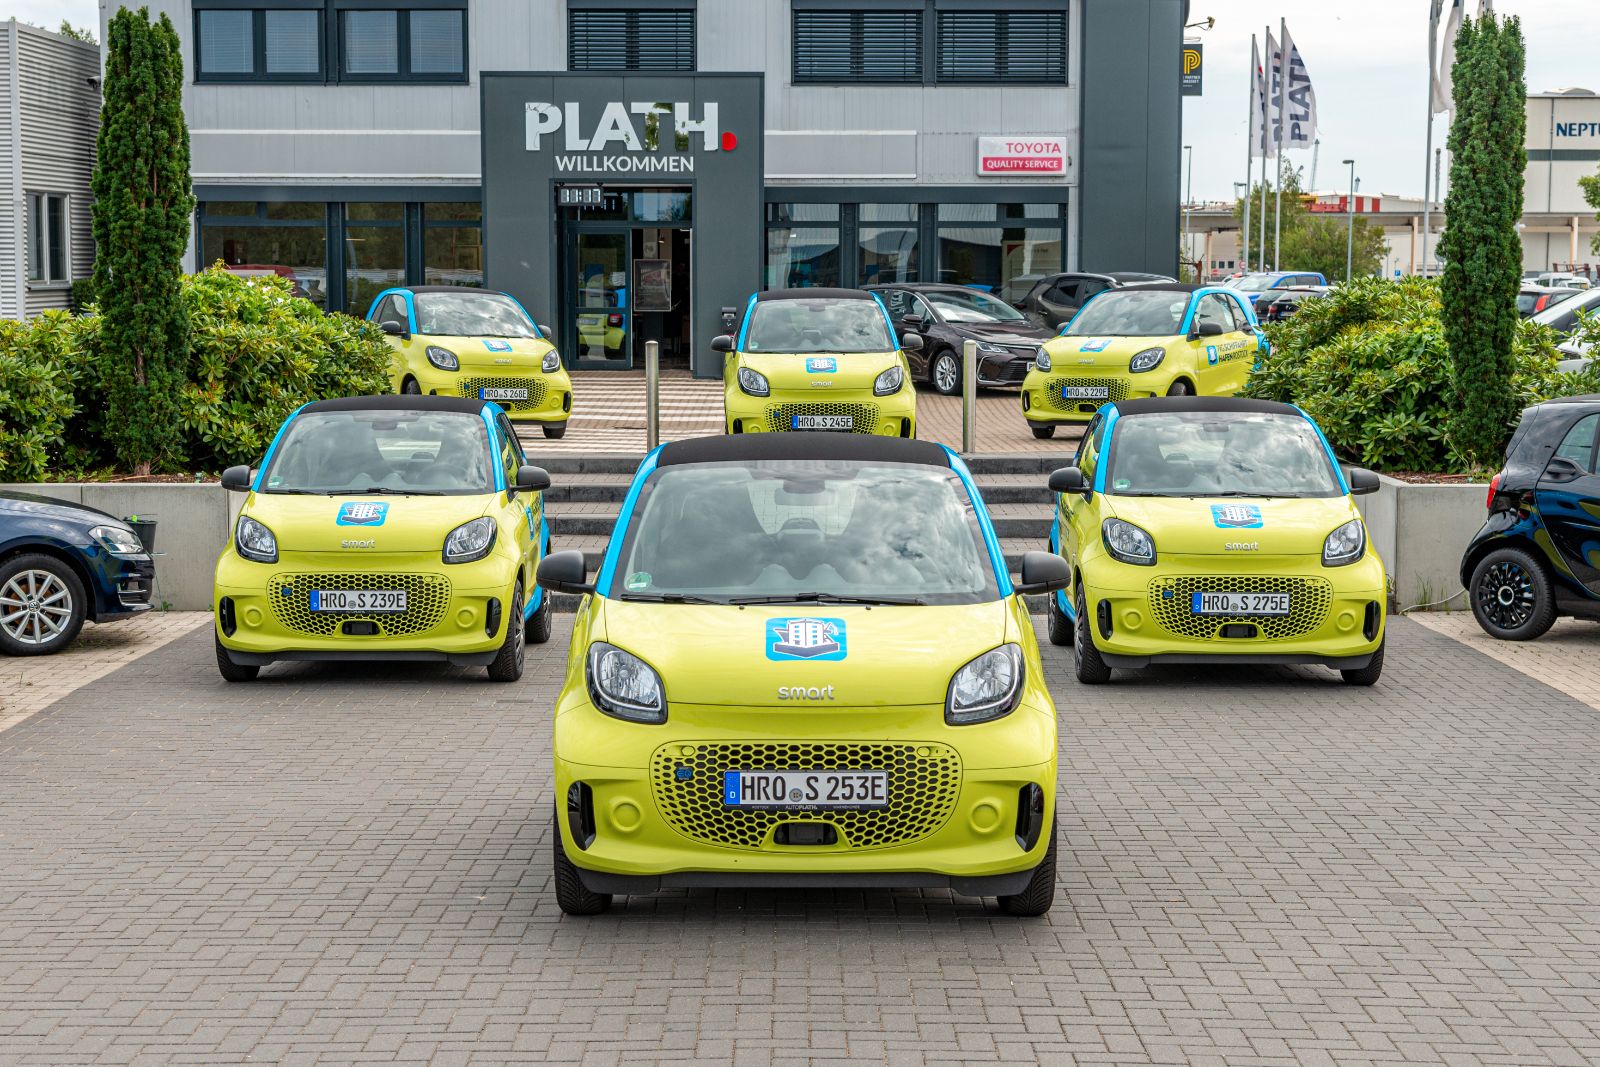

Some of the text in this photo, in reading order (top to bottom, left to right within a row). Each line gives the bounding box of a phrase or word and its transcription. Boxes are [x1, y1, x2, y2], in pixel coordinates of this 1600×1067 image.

[1556, 122, 1600, 137] NEPT
[1006, 143, 1061, 153] TOYOTA
[555, 155, 694, 172] WILLKOMMEN
[986, 160, 1058, 169] QUALITY SERVICE
[484, 389, 499, 399] HRO
[503, 389, 508, 399] S
[798, 417, 852, 427] HRO S 245E
[341, 538, 375, 549] smart
[1225, 541, 1259, 551] smart
[320, 593, 346, 608] HRO
[357, 593, 366, 608] S
[370, 593, 405, 608] 239E
[1202, 595, 1230, 611] HRO
[1240, 595, 1249, 611] S
[1253, 595, 1288, 611] 275E
[777, 684, 835, 700] smart
[729, 775, 885, 801] D HRO S 253E
